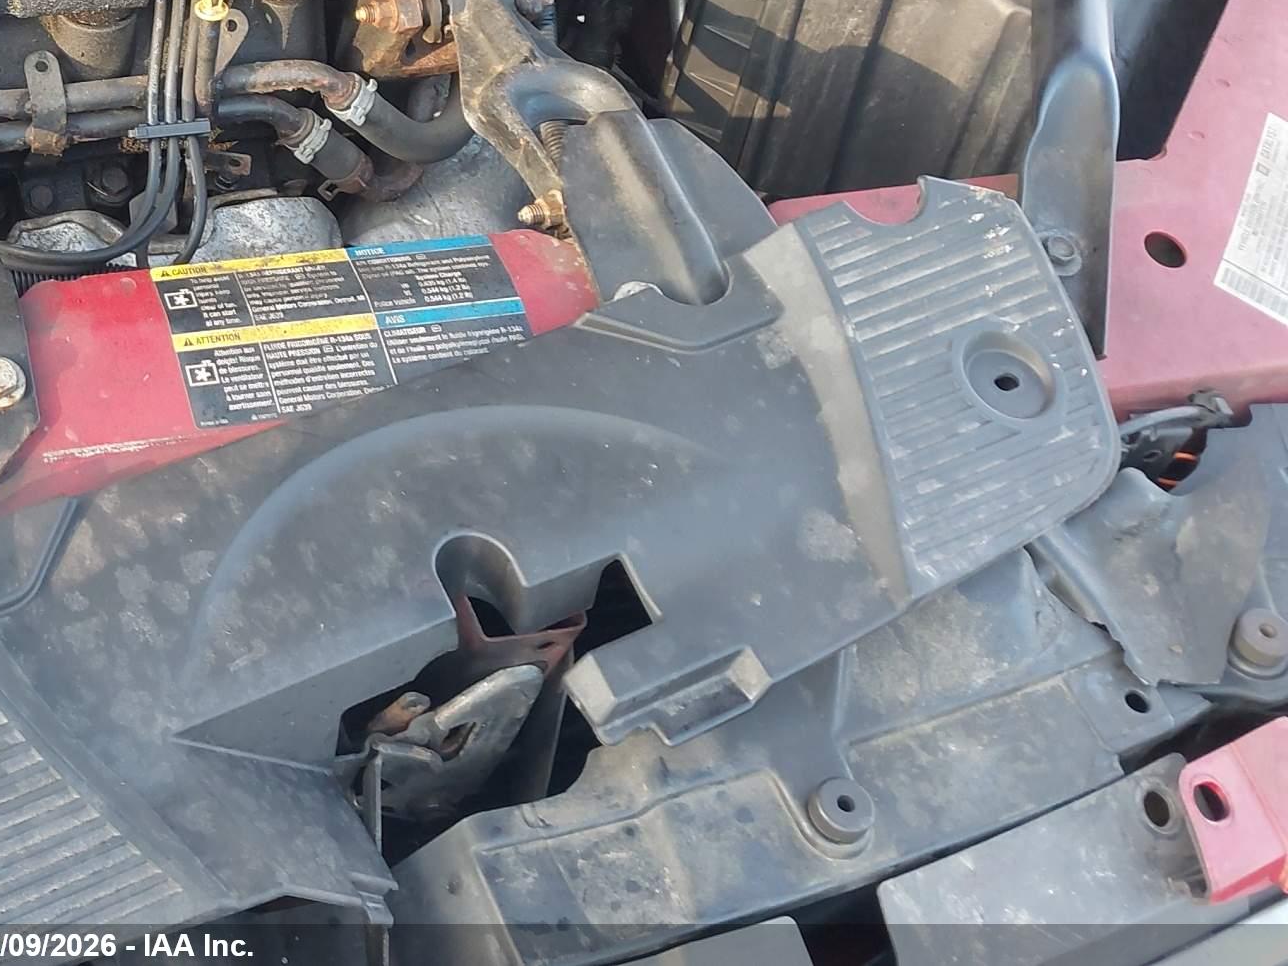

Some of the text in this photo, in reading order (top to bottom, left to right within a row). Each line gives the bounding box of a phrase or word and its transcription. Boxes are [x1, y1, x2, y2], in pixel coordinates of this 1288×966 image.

[354, 247, 386, 257] NOTICE
[171, 267, 207, 276] CAUTION
[252, 305, 276, 313] General
[275, 302, 298, 310] Motors
[384, 315, 406, 324] AVIS
[195, 333, 241, 345] ATTENTION
[213, 348, 243, 357] Attention
[265, 351, 288, 359] HAUTE
[288, 347, 322, 357] PRESSION
[270, 369, 303, 378] personnel
[278, 396, 304, 405] General
[303, 393, 326, 401] Motors
[281, 403, 313, 413] SAE J639
